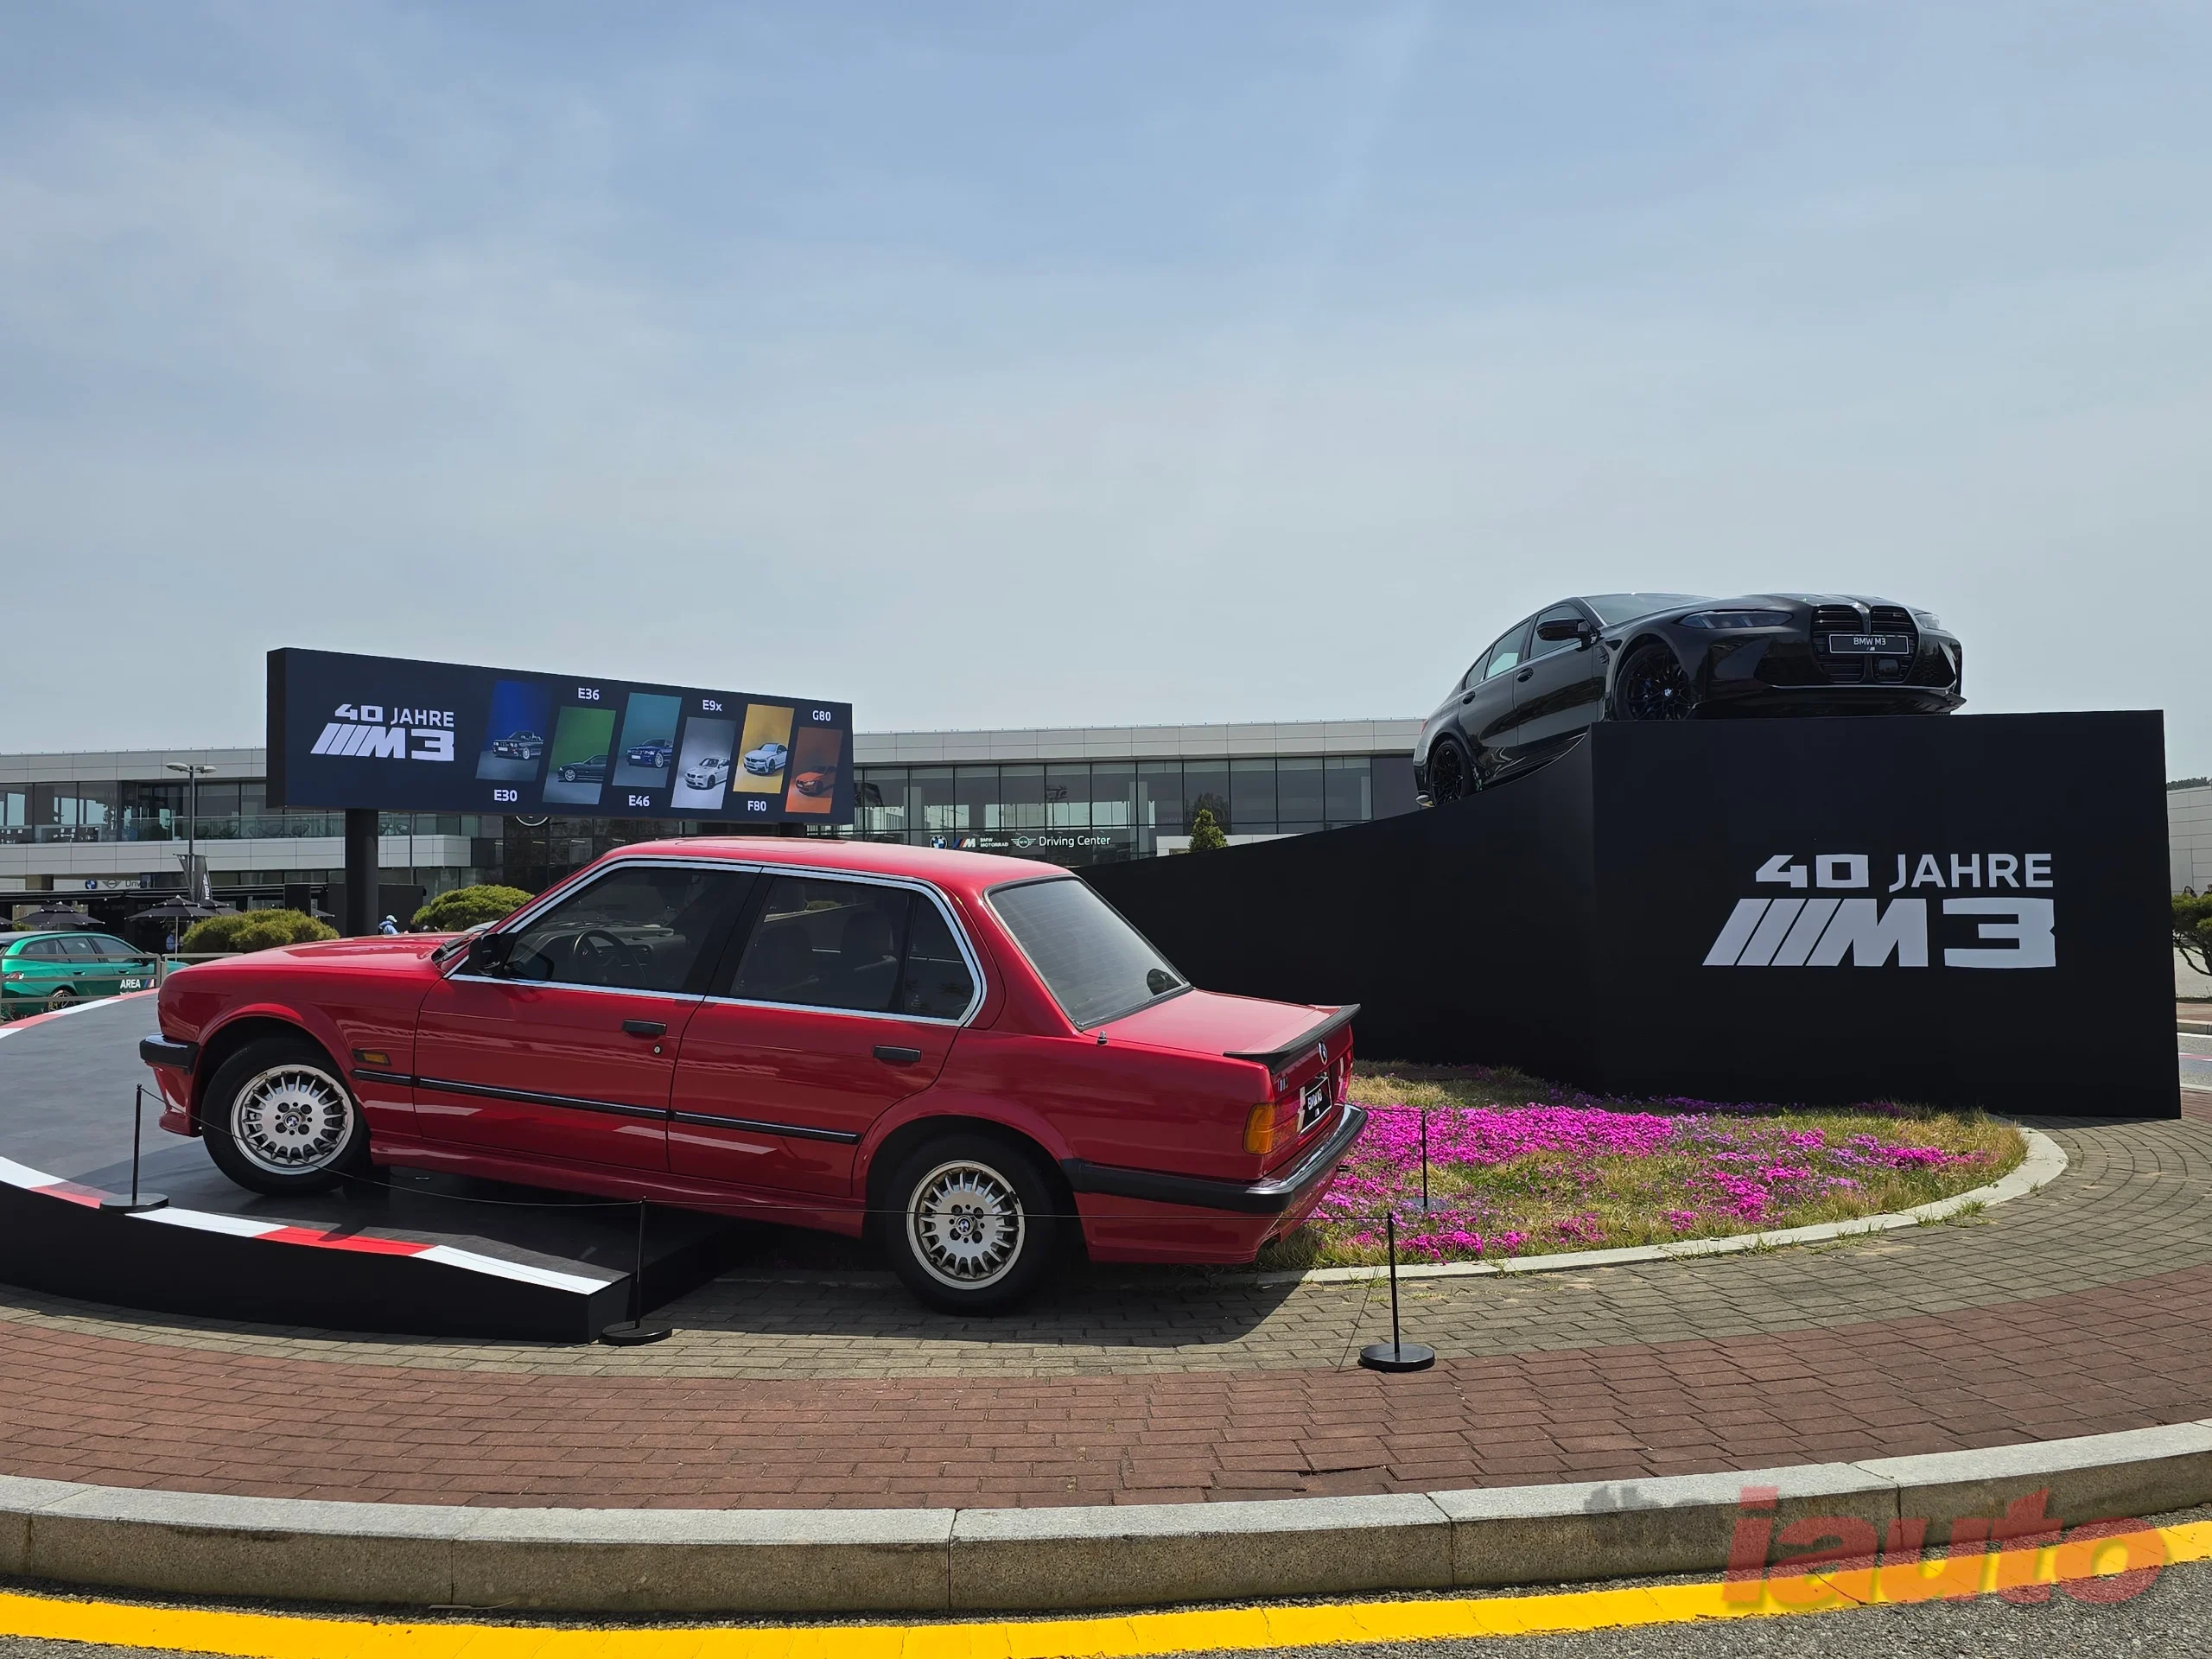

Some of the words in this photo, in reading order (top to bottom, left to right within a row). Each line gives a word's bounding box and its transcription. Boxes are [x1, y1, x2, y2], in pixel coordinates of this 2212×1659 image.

[1853, 637, 1872, 645] BMW
[577, 688, 600, 701] E36
[702, 699, 722, 712] E9x
[334, 703, 383, 722] 40
[390, 707, 454, 728] JAHRE
[812, 709, 831, 721] G80
[493, 789, 518, 803] E30
[628, 794, 650, 807] E46
[747, 800, 767, 811] F80
[1039, 836, 1075, 848] Driving
[1077, 836, 1111, 846] Center
[1756, 854, 1870, 888] 40
[1888, 853, 2054, 893] JAHRE
[119, 978, 141, 989] AREA
